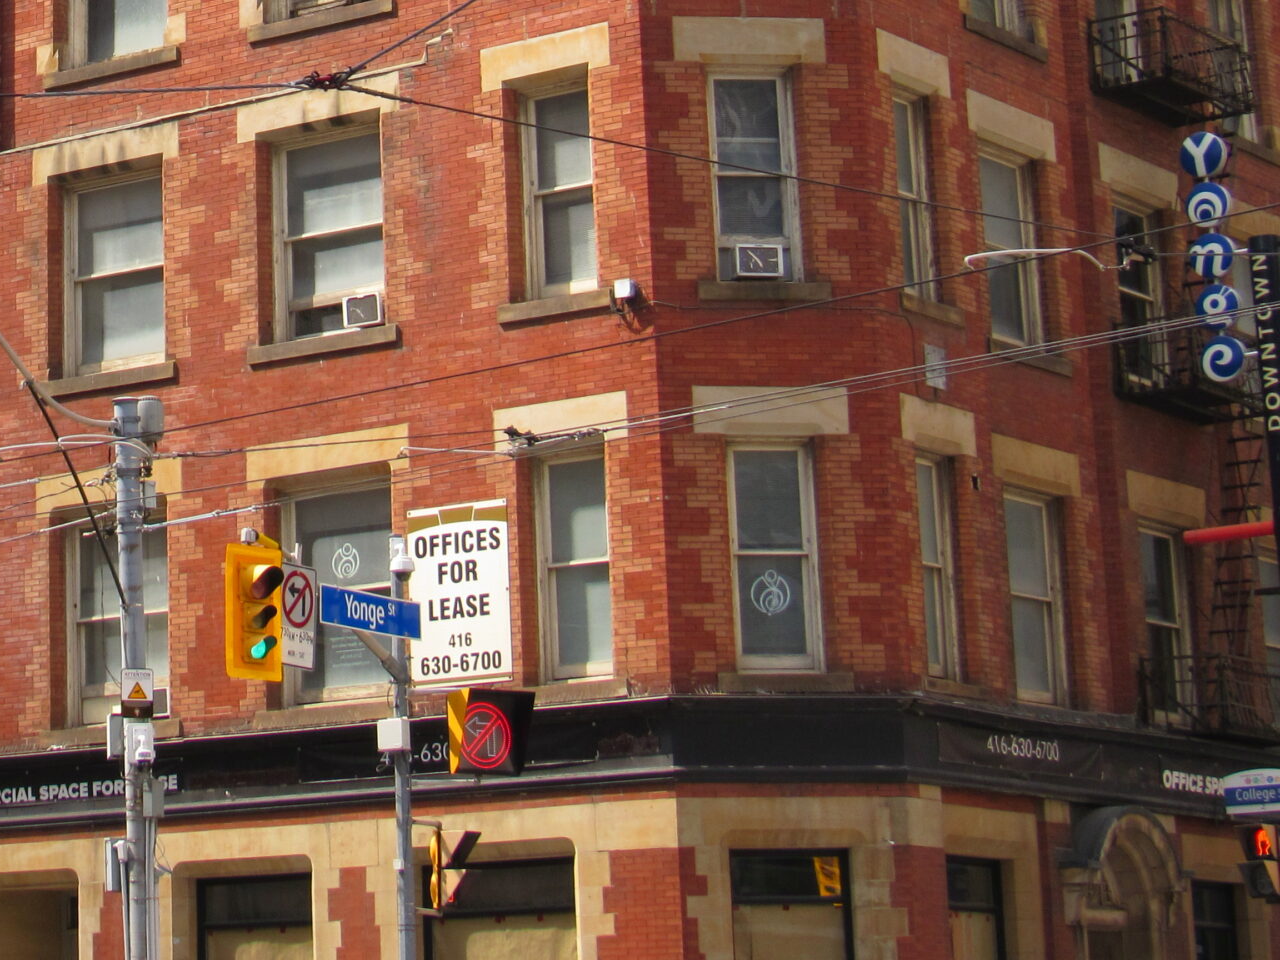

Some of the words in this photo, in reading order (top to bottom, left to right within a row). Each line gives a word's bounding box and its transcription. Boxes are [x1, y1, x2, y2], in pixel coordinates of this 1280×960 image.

[1182, 133, 1233, 382] Yonge
[1252, 254, 1280, 431] DOWNTOWN
[414, 526, 500, 559] OFFICES
[438, 559, 478, 585] FOR
[344, 593, 385, 630] Yonge
[388, 602, 396, 617] St
[428, 593, 491, 622] LEASE
[449, 632, 472, 648] 416
[420, 650, 502, 676] 630-6700
[986, 735, 1060, 762] 416-630-6700
[39, 783, 89, 801] SPACE
[92, 779, 125, 797] FOR
[1163, 769, 1203, 793] OFFICE
[1205, 775, 1225, 796] SPA
[1235, 788, 1276, 802] College
